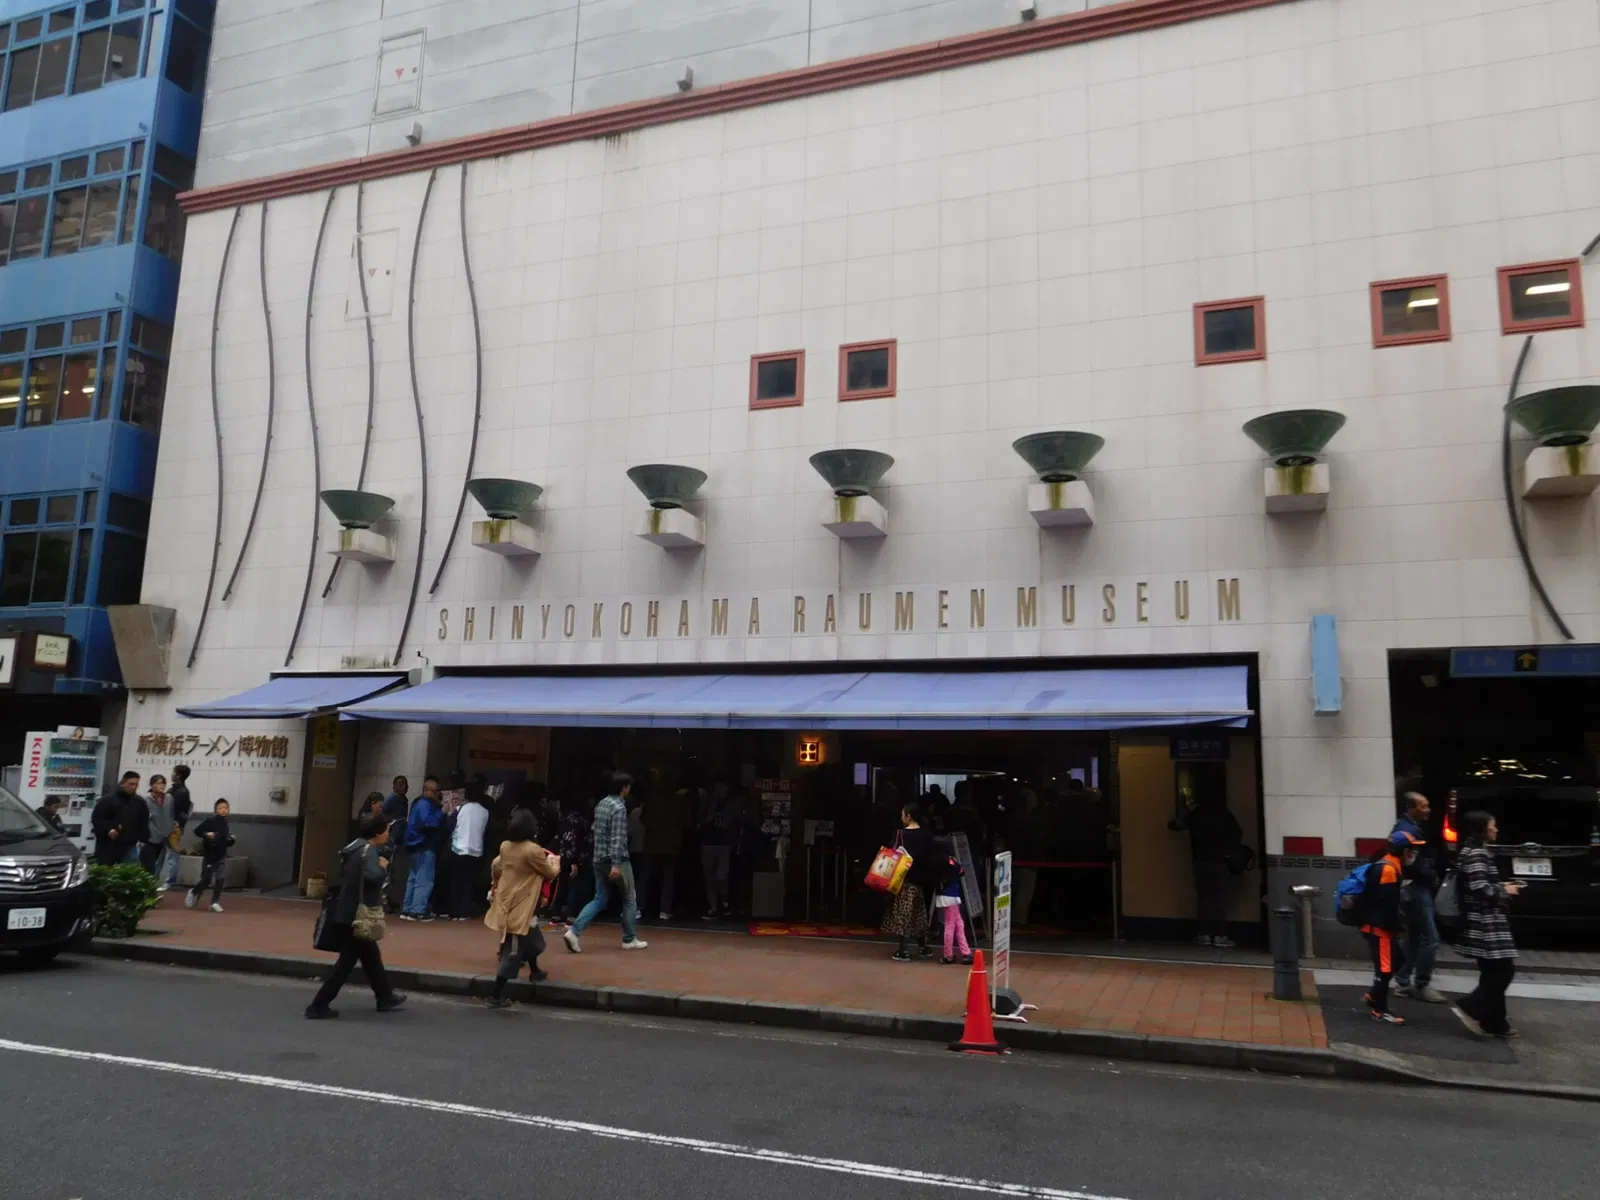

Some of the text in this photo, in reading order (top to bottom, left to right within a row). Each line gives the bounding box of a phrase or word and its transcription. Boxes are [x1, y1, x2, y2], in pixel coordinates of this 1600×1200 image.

[437, 577, 1241, 641] SHINYOKOHAMA RAUMEN MUSEUM
[28, 737, 43, 788] KIRIN
[136, 733, 289, 759] 新横浜ラーメン博物館
